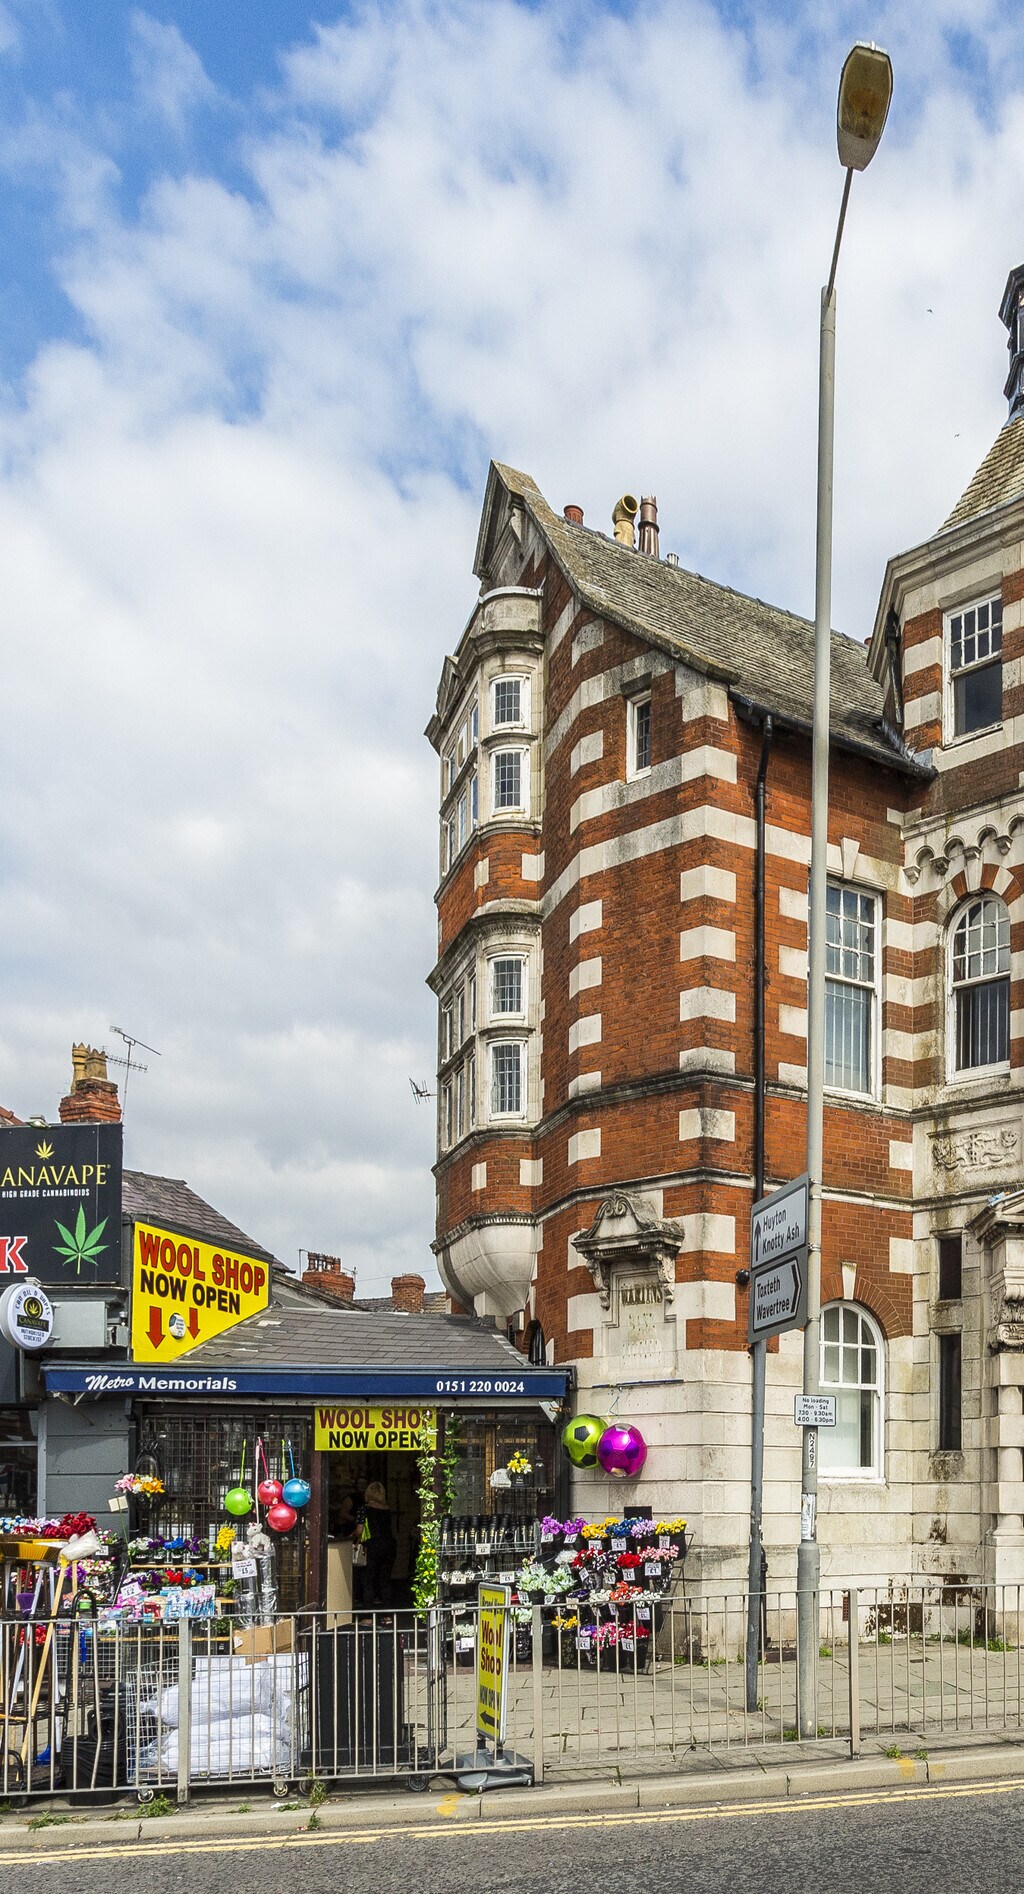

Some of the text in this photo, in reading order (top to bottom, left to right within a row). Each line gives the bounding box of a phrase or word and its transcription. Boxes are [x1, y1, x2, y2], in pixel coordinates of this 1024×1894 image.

[2, 1188, 90, 1198] HIGH GRADE CANNABINOIDS
[762, 1208, 787, 1233] Huyton
[761, 1222, 800, 1255] Knotty Ash
[0, 1236, 29, 1273] K
[139, 1230, 266, 1297] WOOL SHOP
[140, 1268, 241, 1316] NOW OPEN
[756, 1275, 781, 1299] Toxteth
[756, 1297, 790, 1322] Wavertree
[85, 1375, 237, 1390] Metro Memorials
[436, 1381, 525, 1392] 0151 220 0024
[318, 1409, 375, 1429] WOOL
[328, 1431, 422, 1449] NOW OPEN
